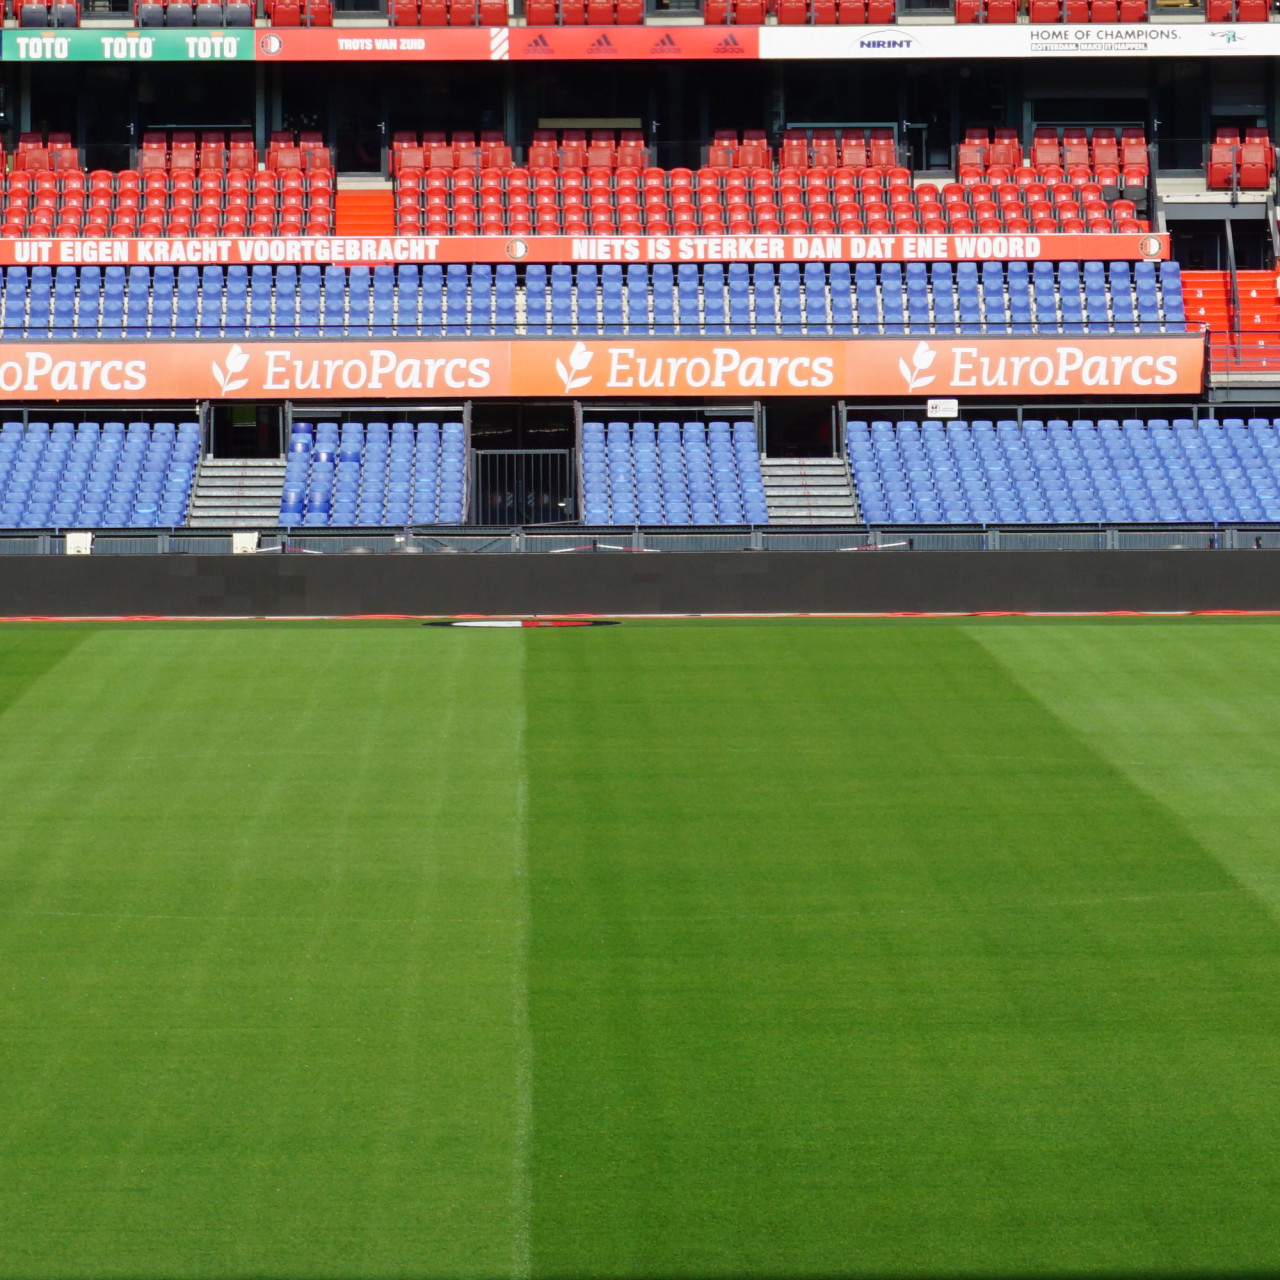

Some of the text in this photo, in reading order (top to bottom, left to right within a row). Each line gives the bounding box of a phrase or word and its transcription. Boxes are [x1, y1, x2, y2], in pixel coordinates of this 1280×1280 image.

[1030, 29, 1182, 41] HOME OF CHAMPIONS.
[337, 38, 426, 50] TROTS VAN ZUID
[650, 46, 682, 54] adidas
[713, 45, 745, 54] adidas
[859, 39, 913, 49] NIRINT
[1080, 43, 1103, 51] MAKE
[1104, 43, 1113, 51] IT
[523, 46, 554, 55] adidas
[587, 46, 618, 55] adidas
[15, 239, 439, 262] UIT EIGEN KRACHT VOORTGEBRACHT
[572, 237, 1041, 260] NIETS IS STERKER DAN DAT ENE WOORD
[263, 348, 490, 390] EuroParcs
[606, 347, 834, 388] EuroParcs
[950, 346, 1178, 387] EuroParcs
